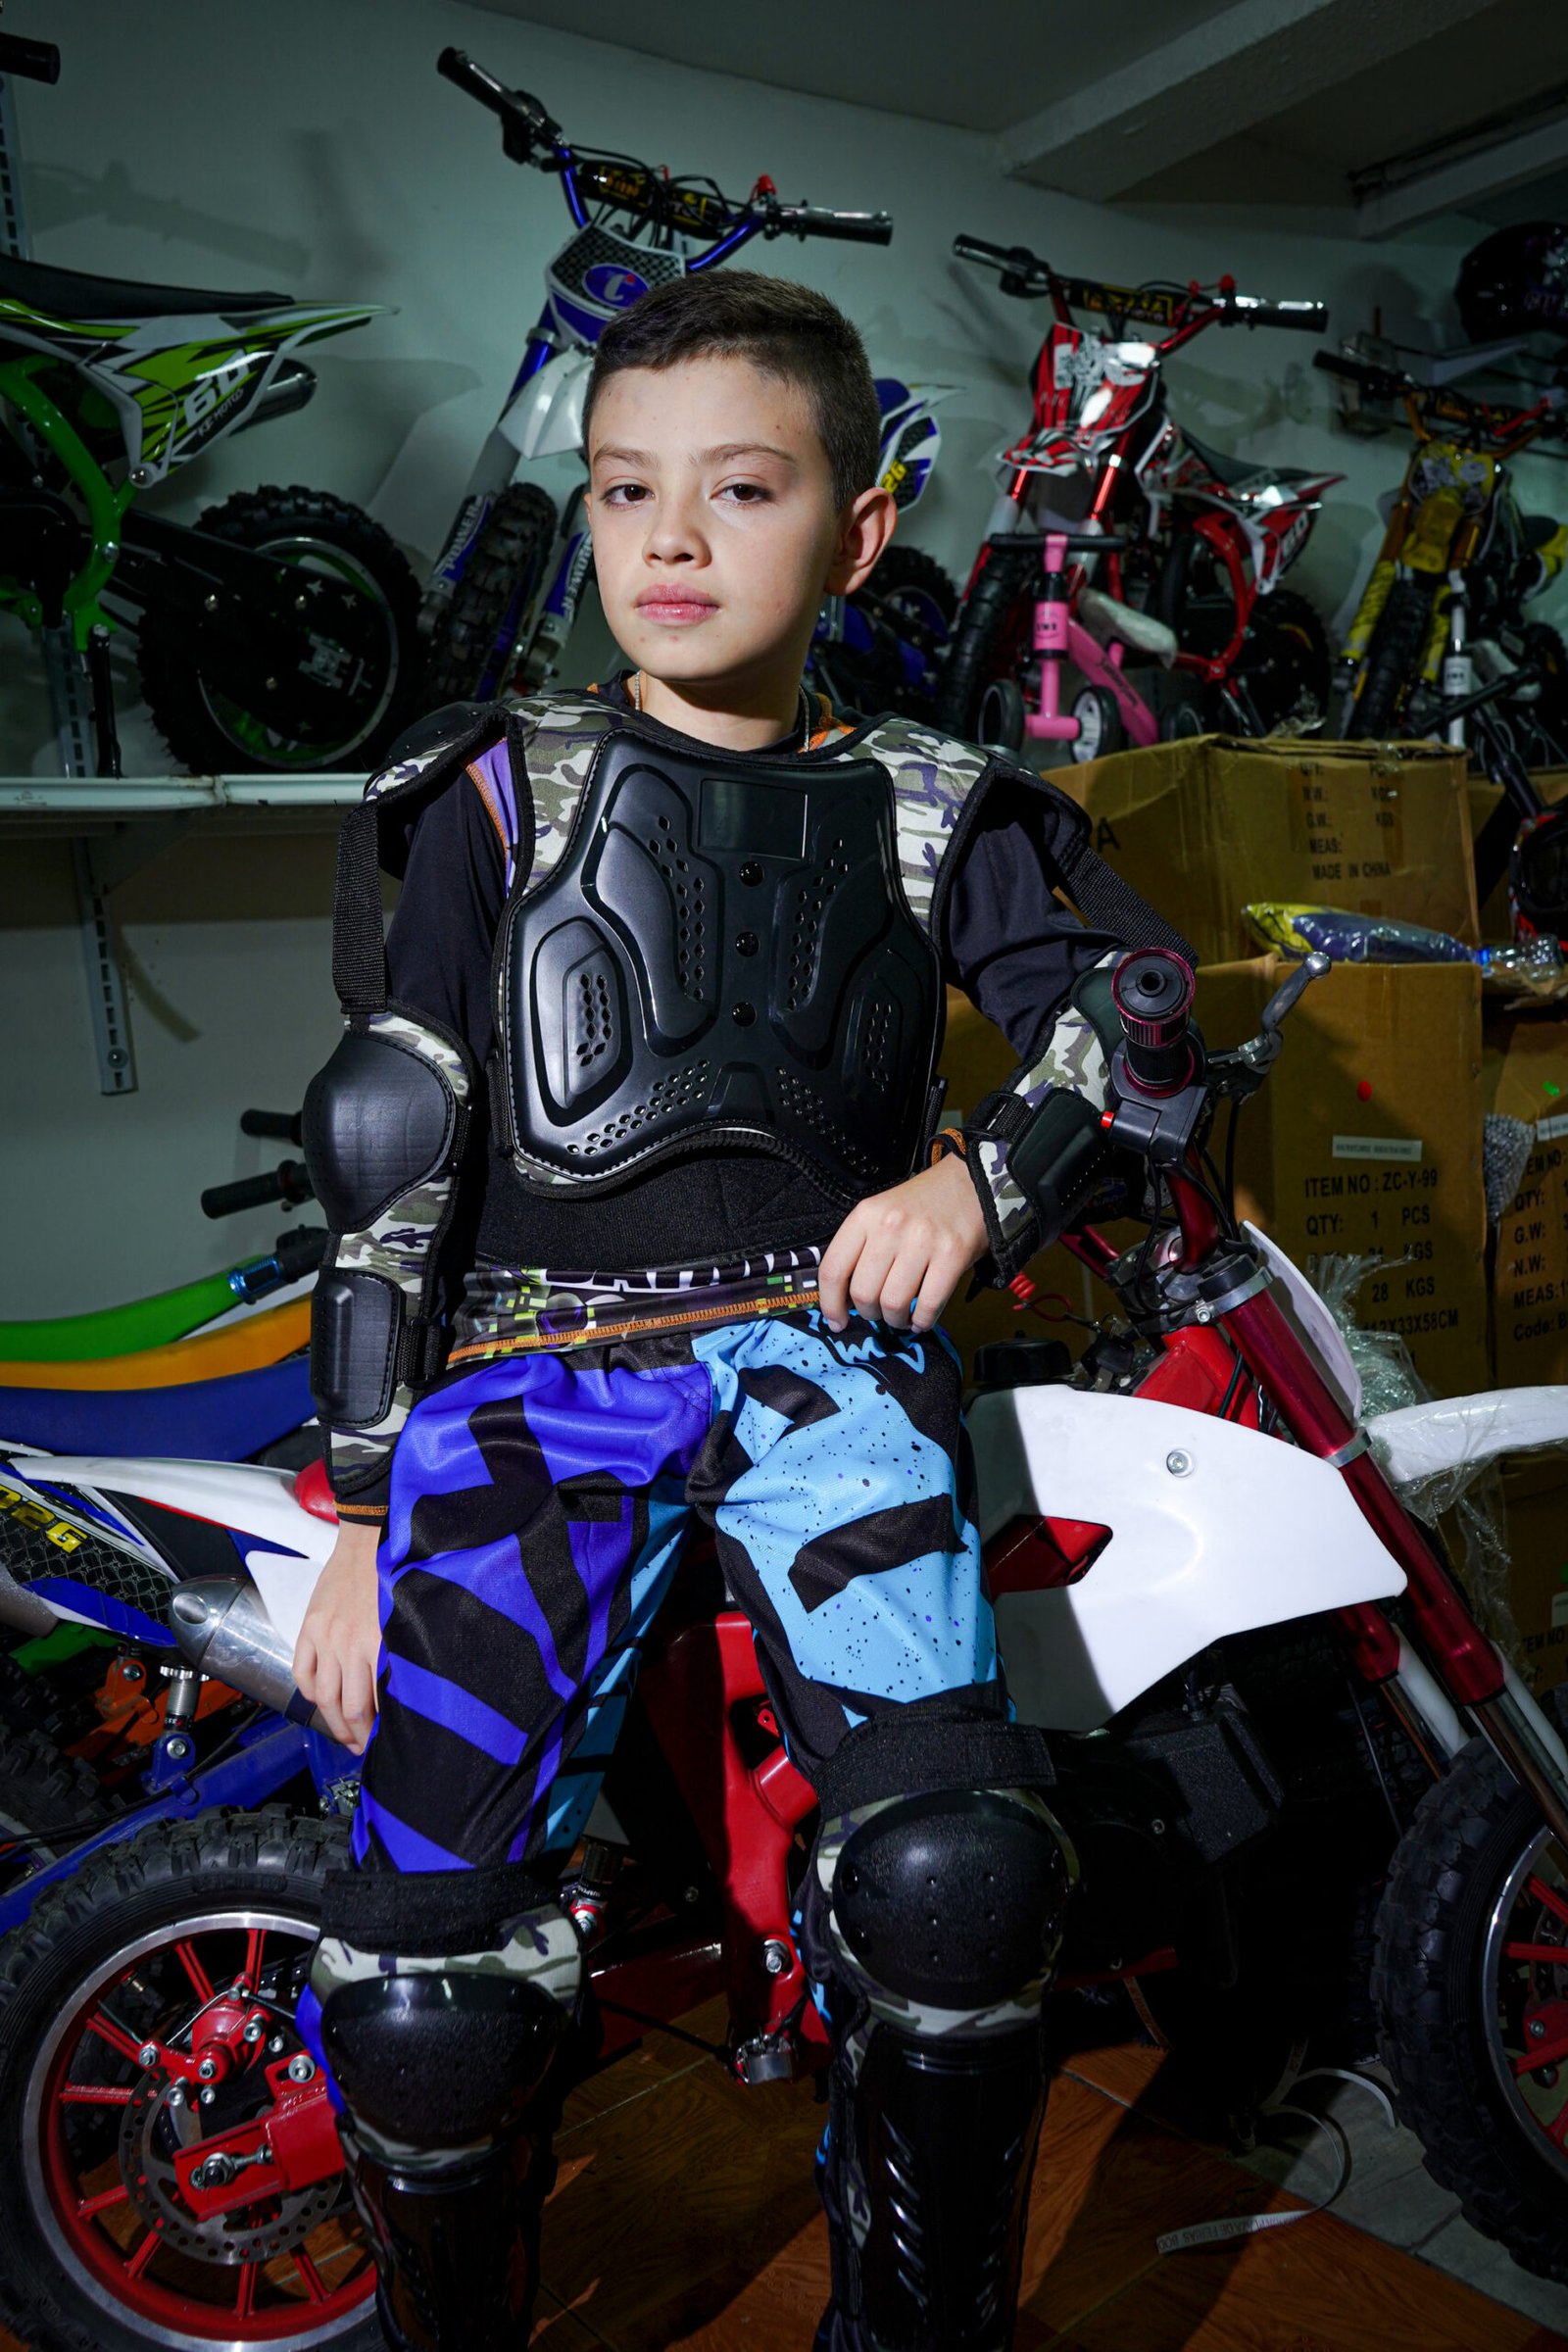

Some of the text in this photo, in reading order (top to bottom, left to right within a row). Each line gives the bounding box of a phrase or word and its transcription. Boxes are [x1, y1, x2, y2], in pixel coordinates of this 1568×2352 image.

[446, 503, 480, 571] POWER
[1098, 815, 1120, 853] A
[1312, 860, 1392, 880] MADE IN CHINA
[1304, 1176, 1344, 1198] ITEM
[1383, 1168, 1438, 1193] ZC-Y-99
[1514, 1190, 1545, 1212] QTY:
[1305, 1205, 1431, 1236] QTY: 1 PCS
[1372, 1276, 1436, 1303] 28 KGS
